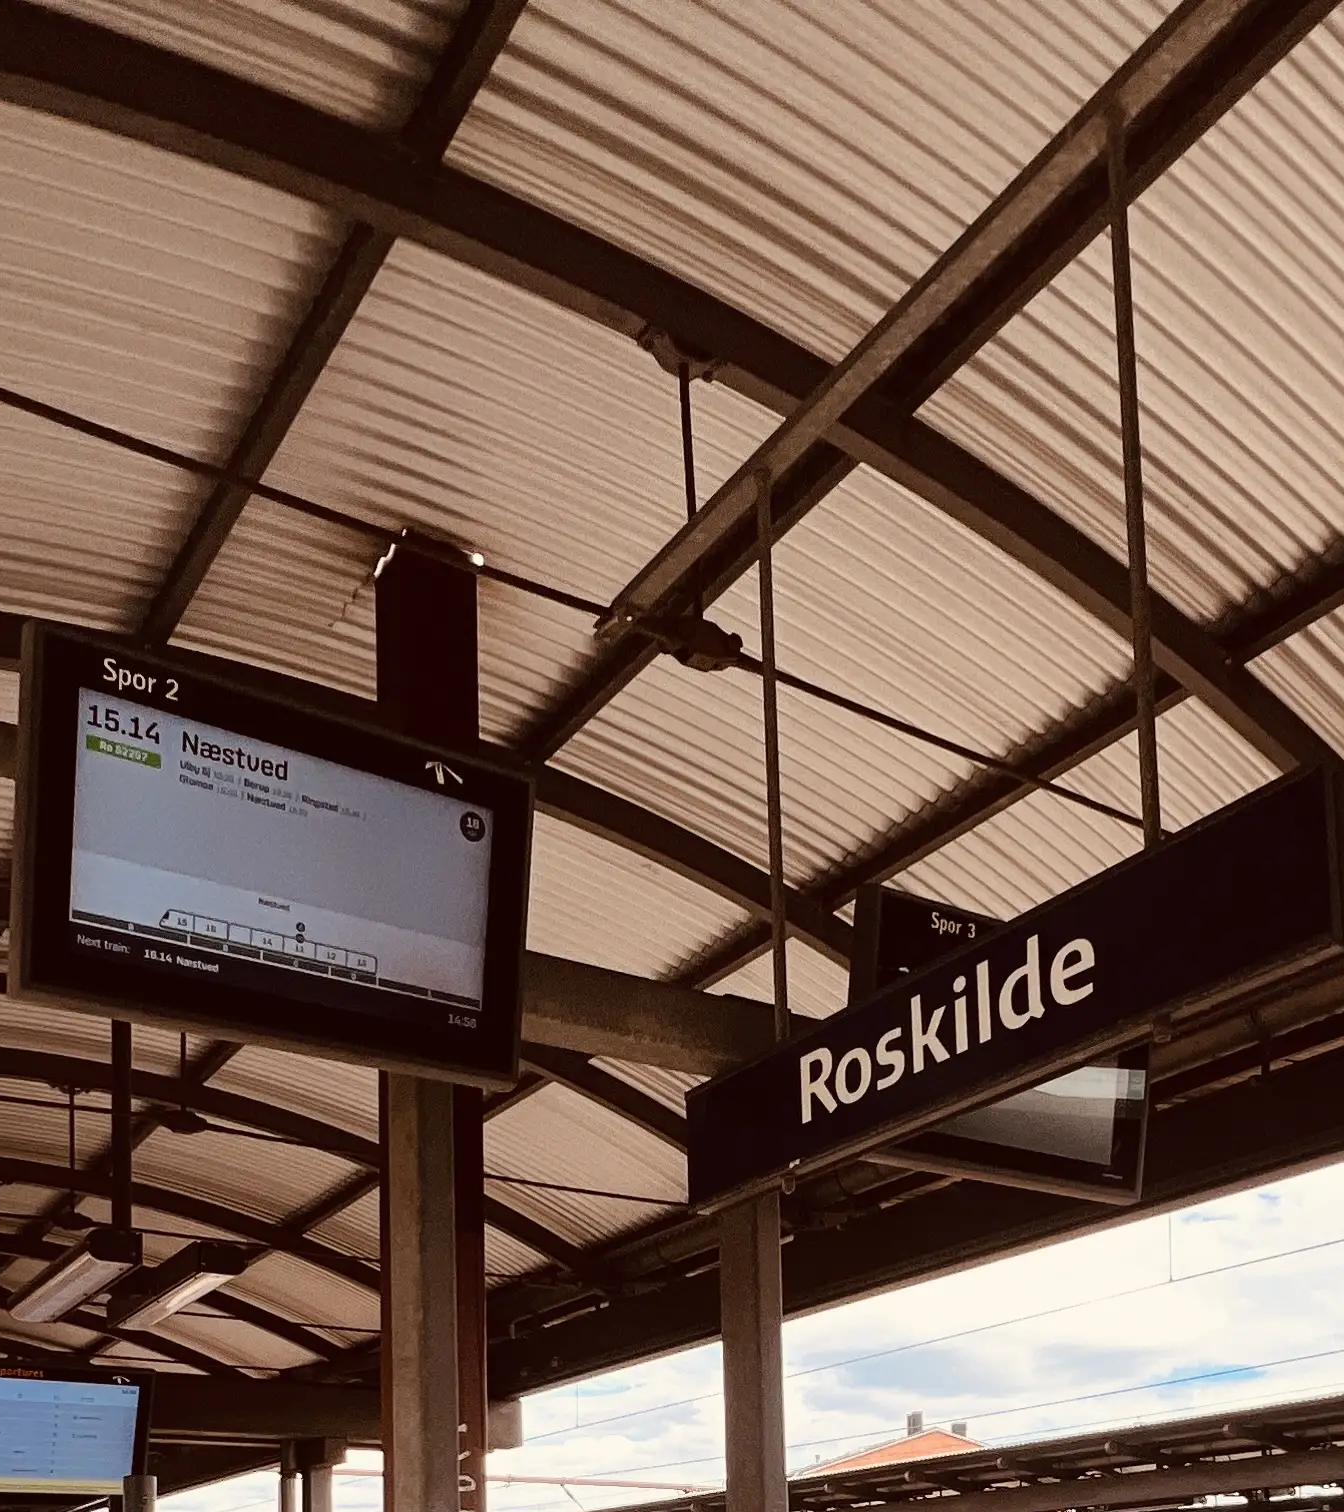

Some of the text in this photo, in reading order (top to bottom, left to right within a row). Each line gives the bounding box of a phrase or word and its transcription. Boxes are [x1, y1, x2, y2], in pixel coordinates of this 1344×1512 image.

[102, 657, 179, 701] Spor 2
[86, 704, 161, 745] 15.14
[181, 730, 289, 781] Næstved
[77, 933, 102, 950] Next
[930, 911, 976, 938] Spor 3
[798, 933, 1097, 1126] Roskilde
